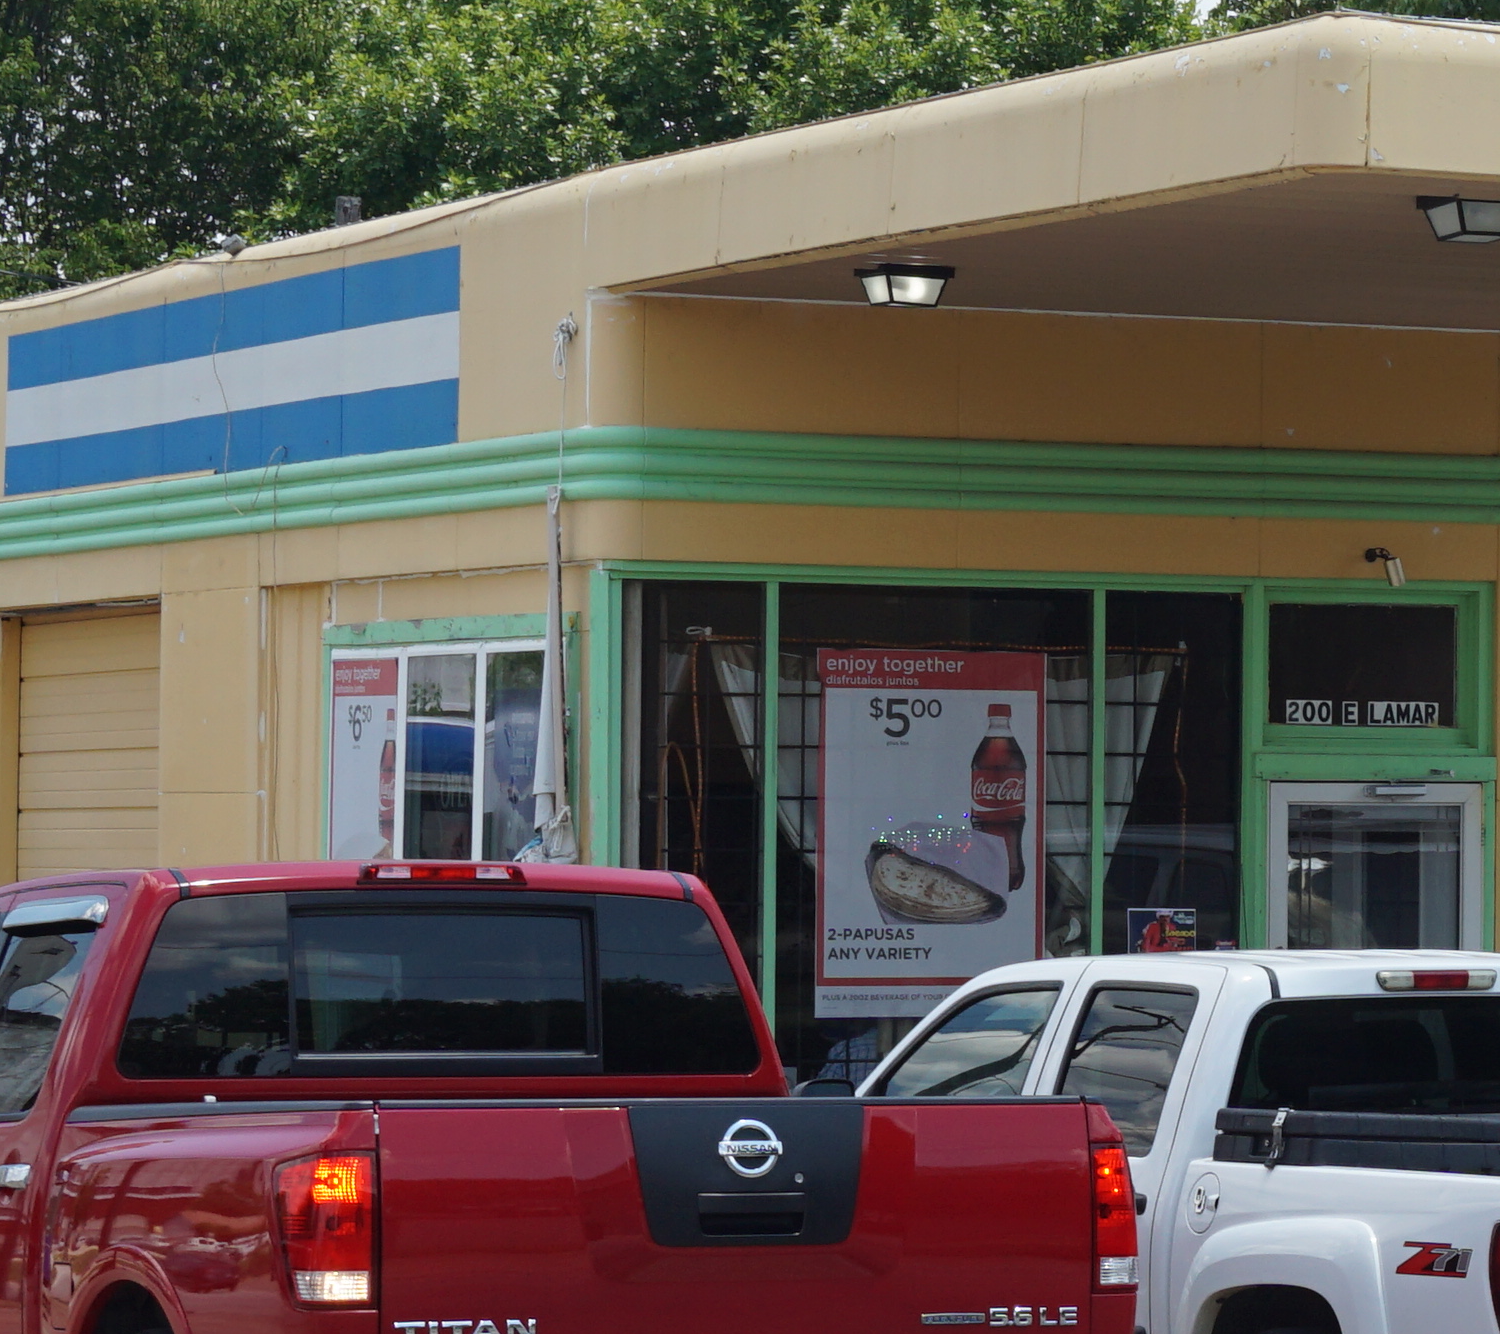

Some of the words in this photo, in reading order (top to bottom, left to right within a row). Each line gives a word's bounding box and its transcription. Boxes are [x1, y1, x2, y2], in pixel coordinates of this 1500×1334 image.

[826, 655, 877, 674] enjoy
[883, 656, 965, 674] together
[825, 674, 883, 685] disfrutalos
[886, 677, 919, 686] juntos
[1287, 701, 1331, 723] 200
[1344, 703, 1356, 724] E
[1369, 703, 1437, 724] LAMAR
[827, 927, 915, 941] 2-PAPUSAS
[827, 947, 861, 960] ANY
[866, 947, 932, 960] VARIETY
[726, 1144, 777, 1153] NISSAN
[1395, 1241, 1473, 1278] Z71
[989, 1306, 1033, 1326] 5.6
[1039, 1306, 1078, 1326] LE
